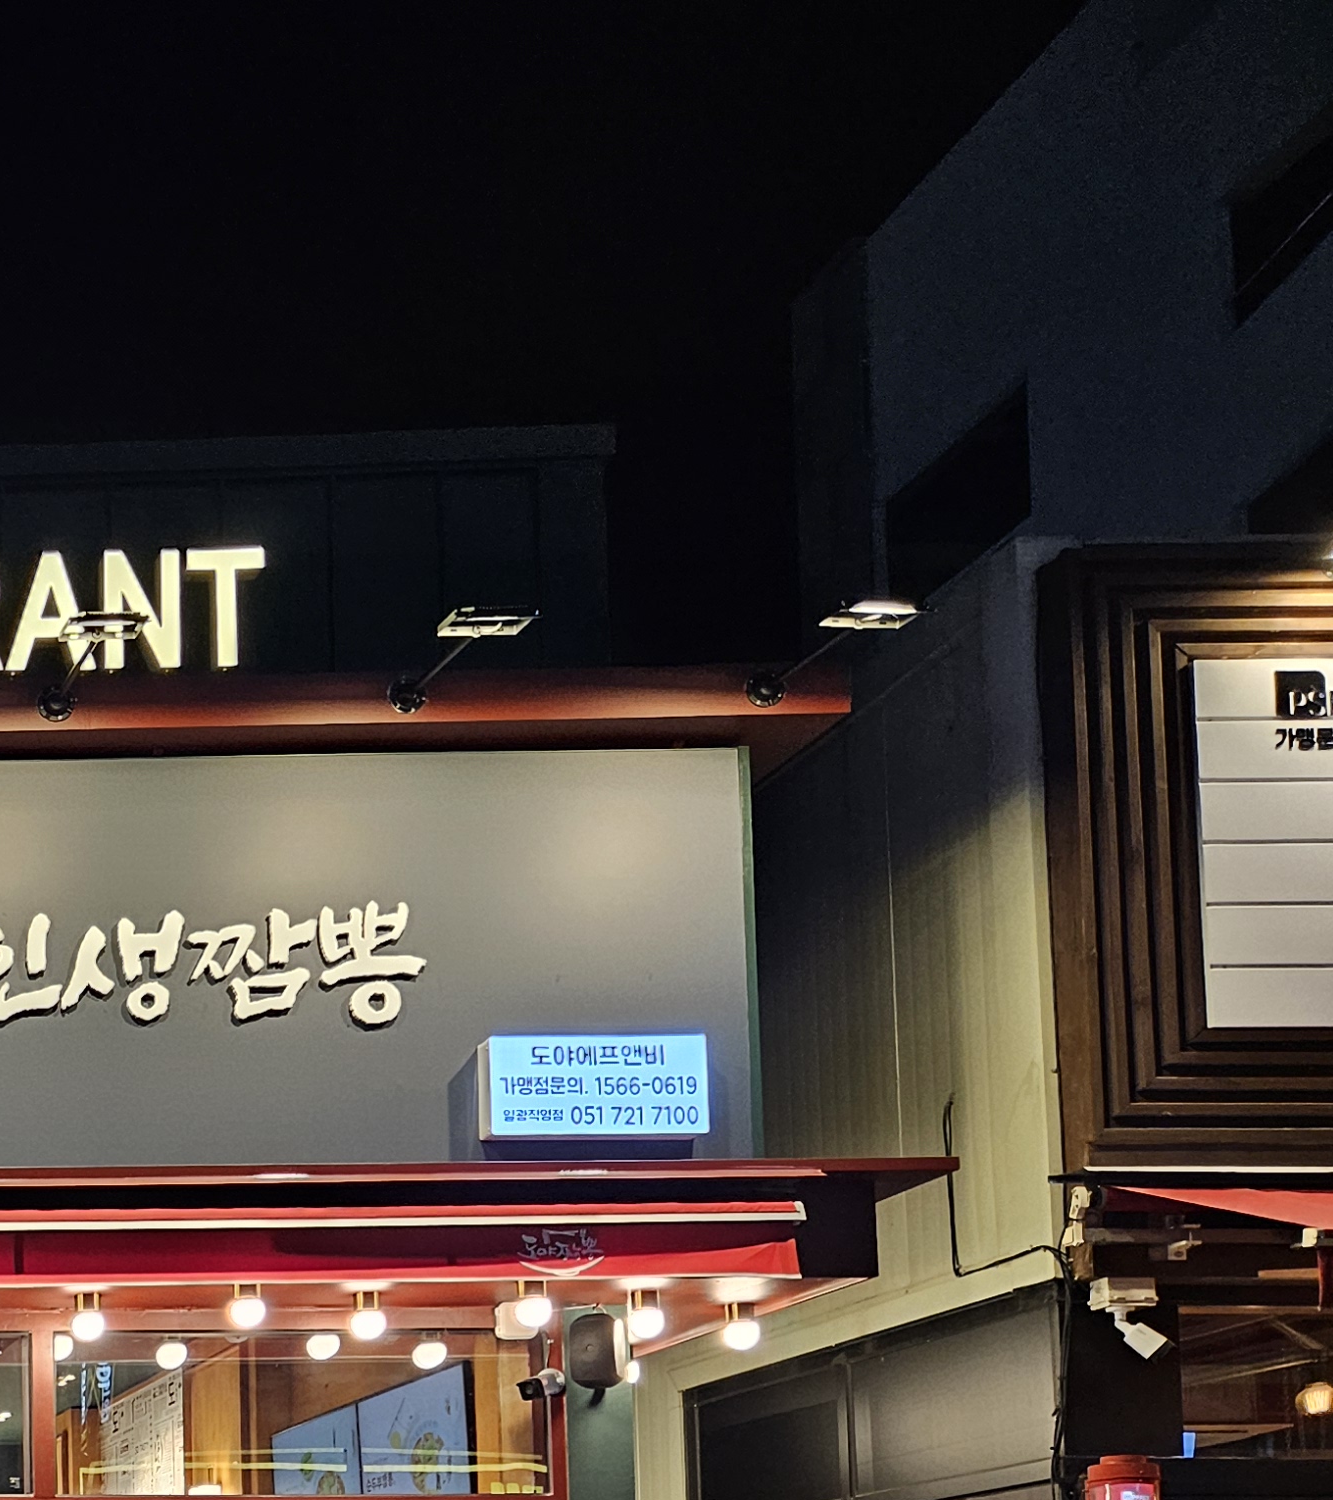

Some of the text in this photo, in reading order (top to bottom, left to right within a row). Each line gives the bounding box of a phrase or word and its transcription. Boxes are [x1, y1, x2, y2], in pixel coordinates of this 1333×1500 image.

[530, 1044, 666, 1067] 도야에프앤비
[499, 1075, 698, 1097] 가맹점문의. 1566-0619
[502, 1105, 700, 1126] 일광직영점 051 721 7100
